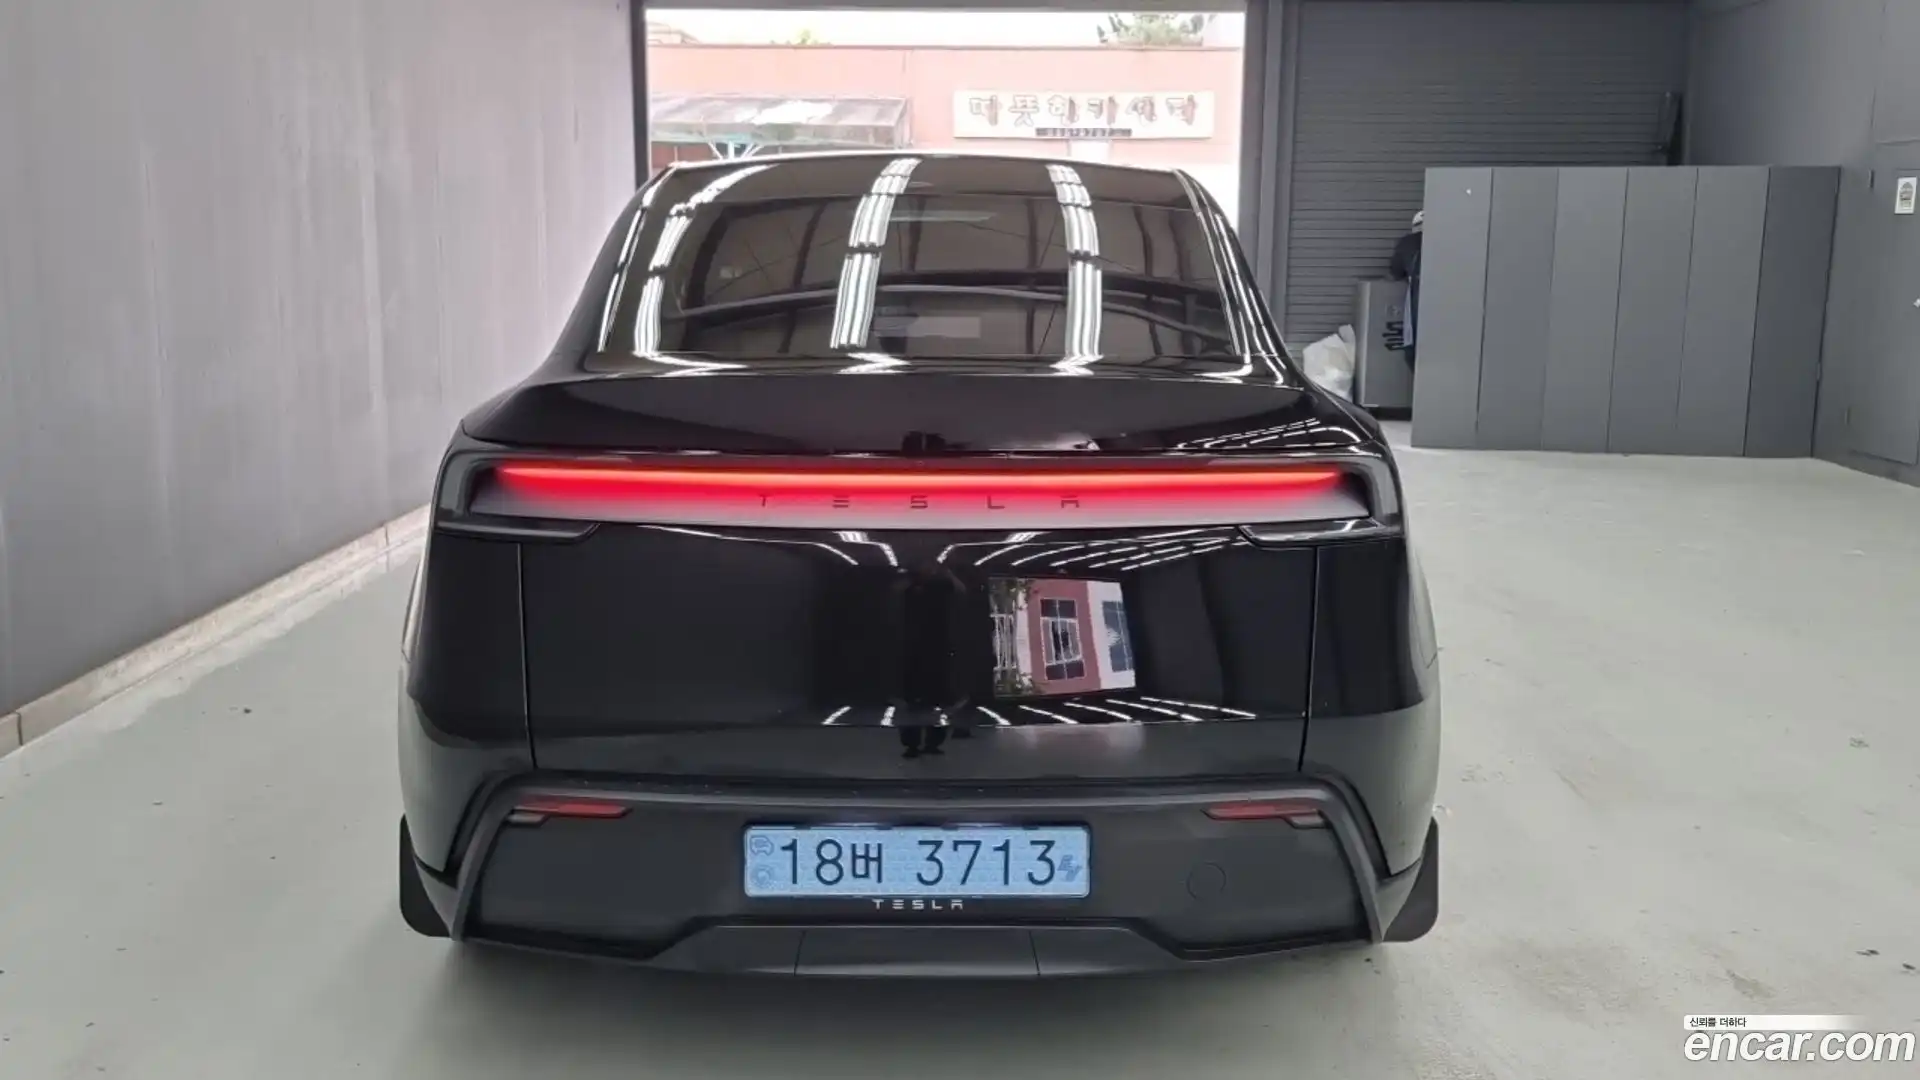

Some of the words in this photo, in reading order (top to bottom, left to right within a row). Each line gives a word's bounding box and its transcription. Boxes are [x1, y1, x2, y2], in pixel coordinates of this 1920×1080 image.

[757, 493, 1082, 509] TESLA
[916, 839, 1057, 886] 3713
[872, 899, 965, 910] TESLA
